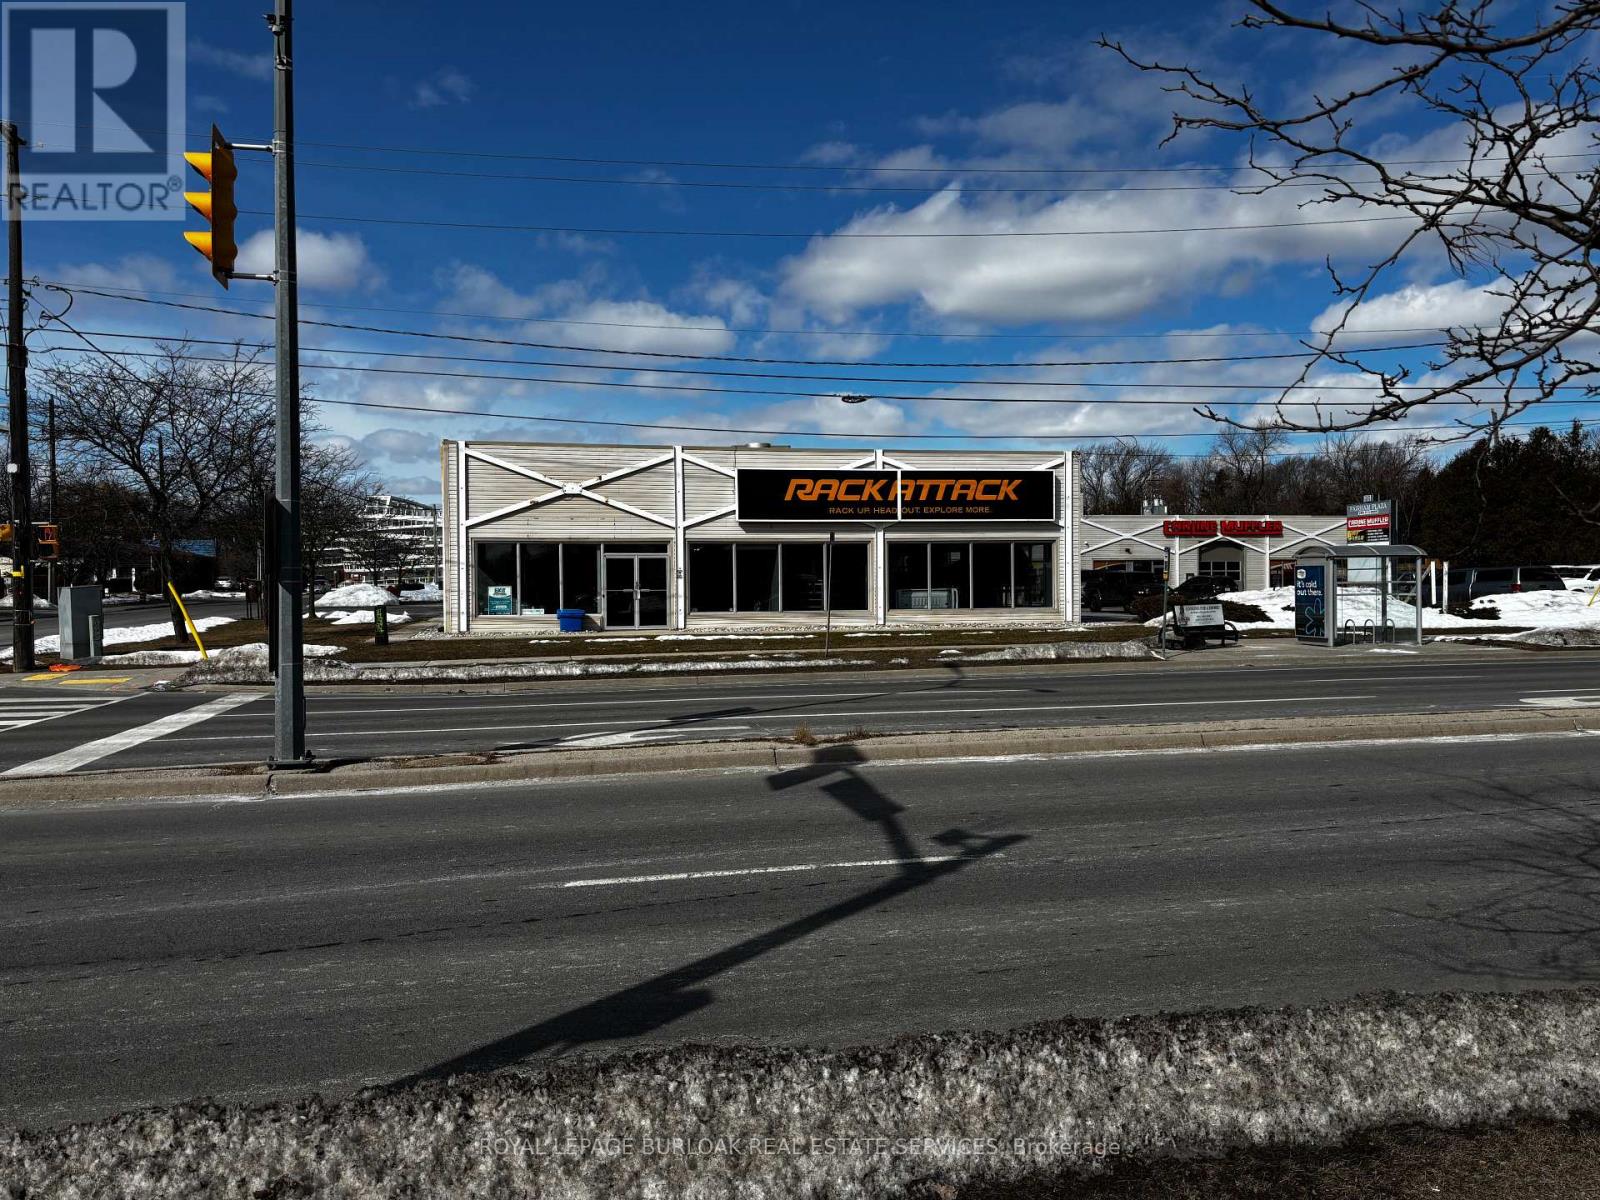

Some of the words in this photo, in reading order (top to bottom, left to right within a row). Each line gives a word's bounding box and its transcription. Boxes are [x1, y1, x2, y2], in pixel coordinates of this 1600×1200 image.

[784, 478, 889, 501] RACK
[887, 479, 1024, 501] ATTACK
[829, 507, 854, 515] RACK
[873, 507, 898, 515] HEAD
[924, 506, 963, 514] EXPLORE
